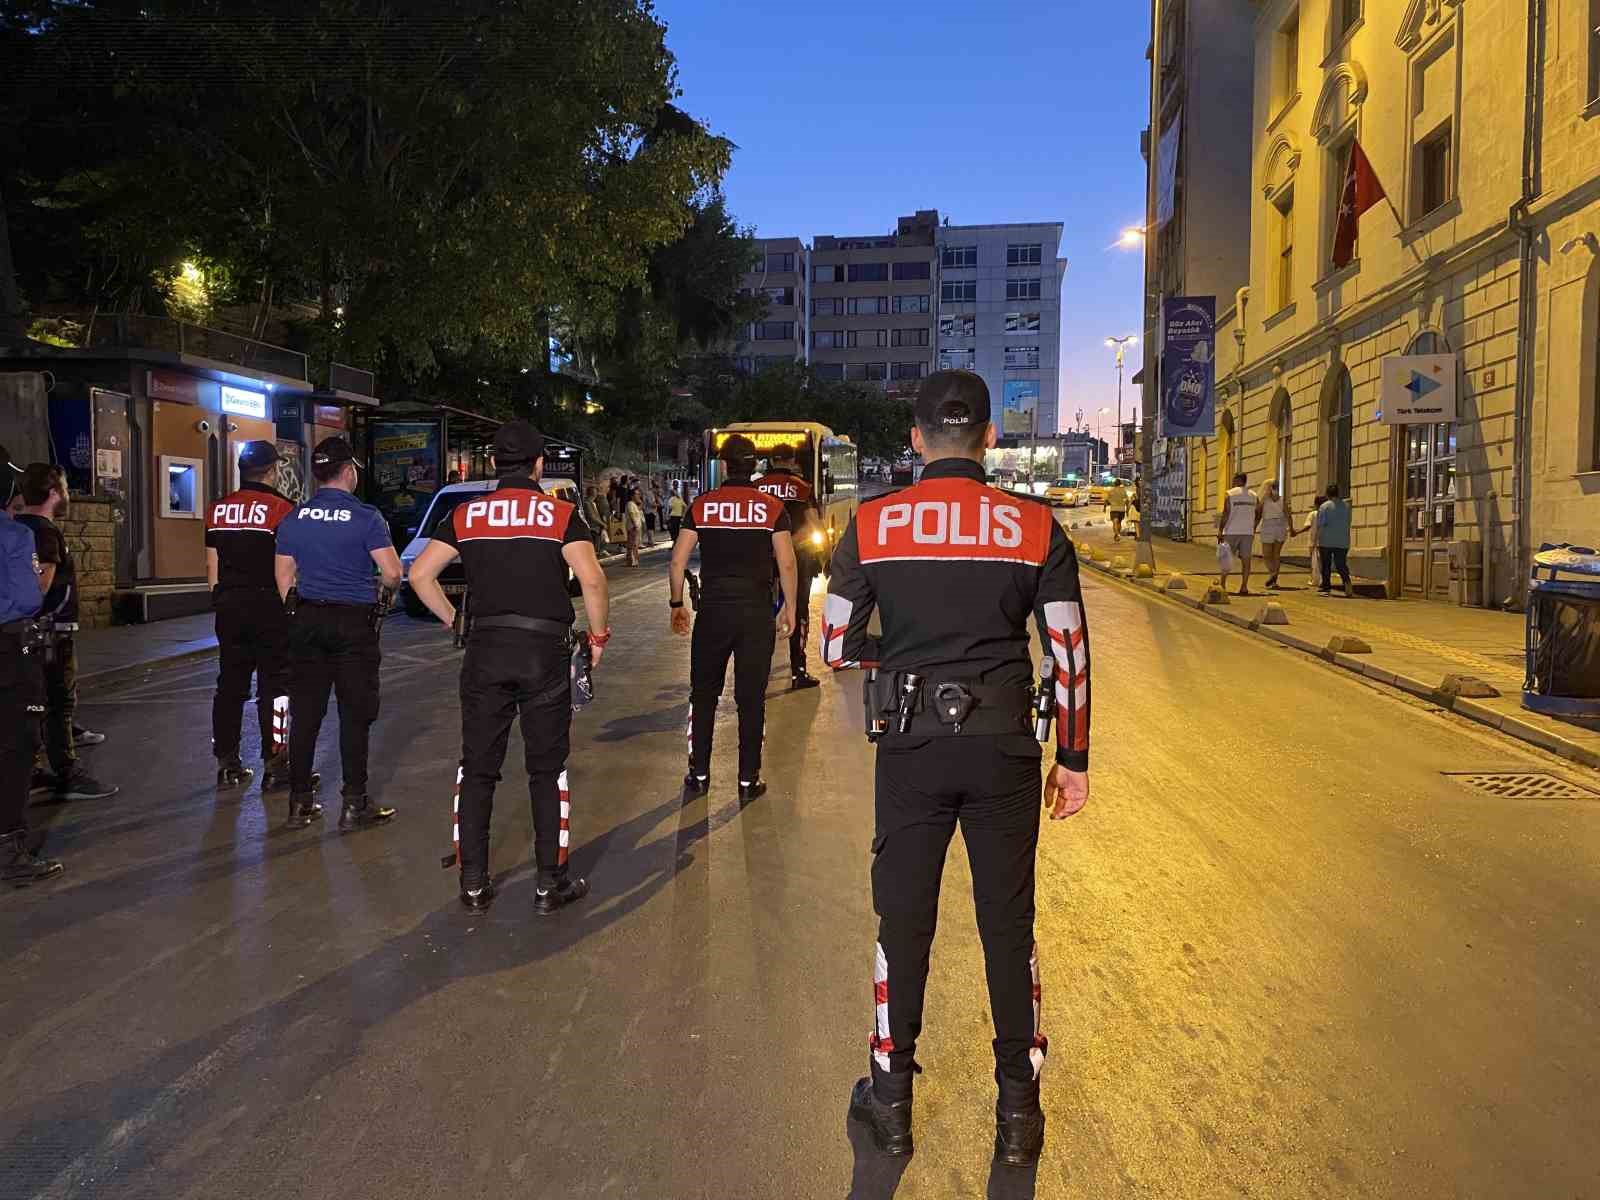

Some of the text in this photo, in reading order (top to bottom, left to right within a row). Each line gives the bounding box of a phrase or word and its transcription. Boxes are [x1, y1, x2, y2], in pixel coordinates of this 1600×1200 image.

[213, 501, 268, 525] POLİS
[297, 507, 351, 521] POLIS
[466, 496, 554, 528] POLİS
[703, 500, 767, 523] POLİS
[878, 496, 1023, 548] POLİS
